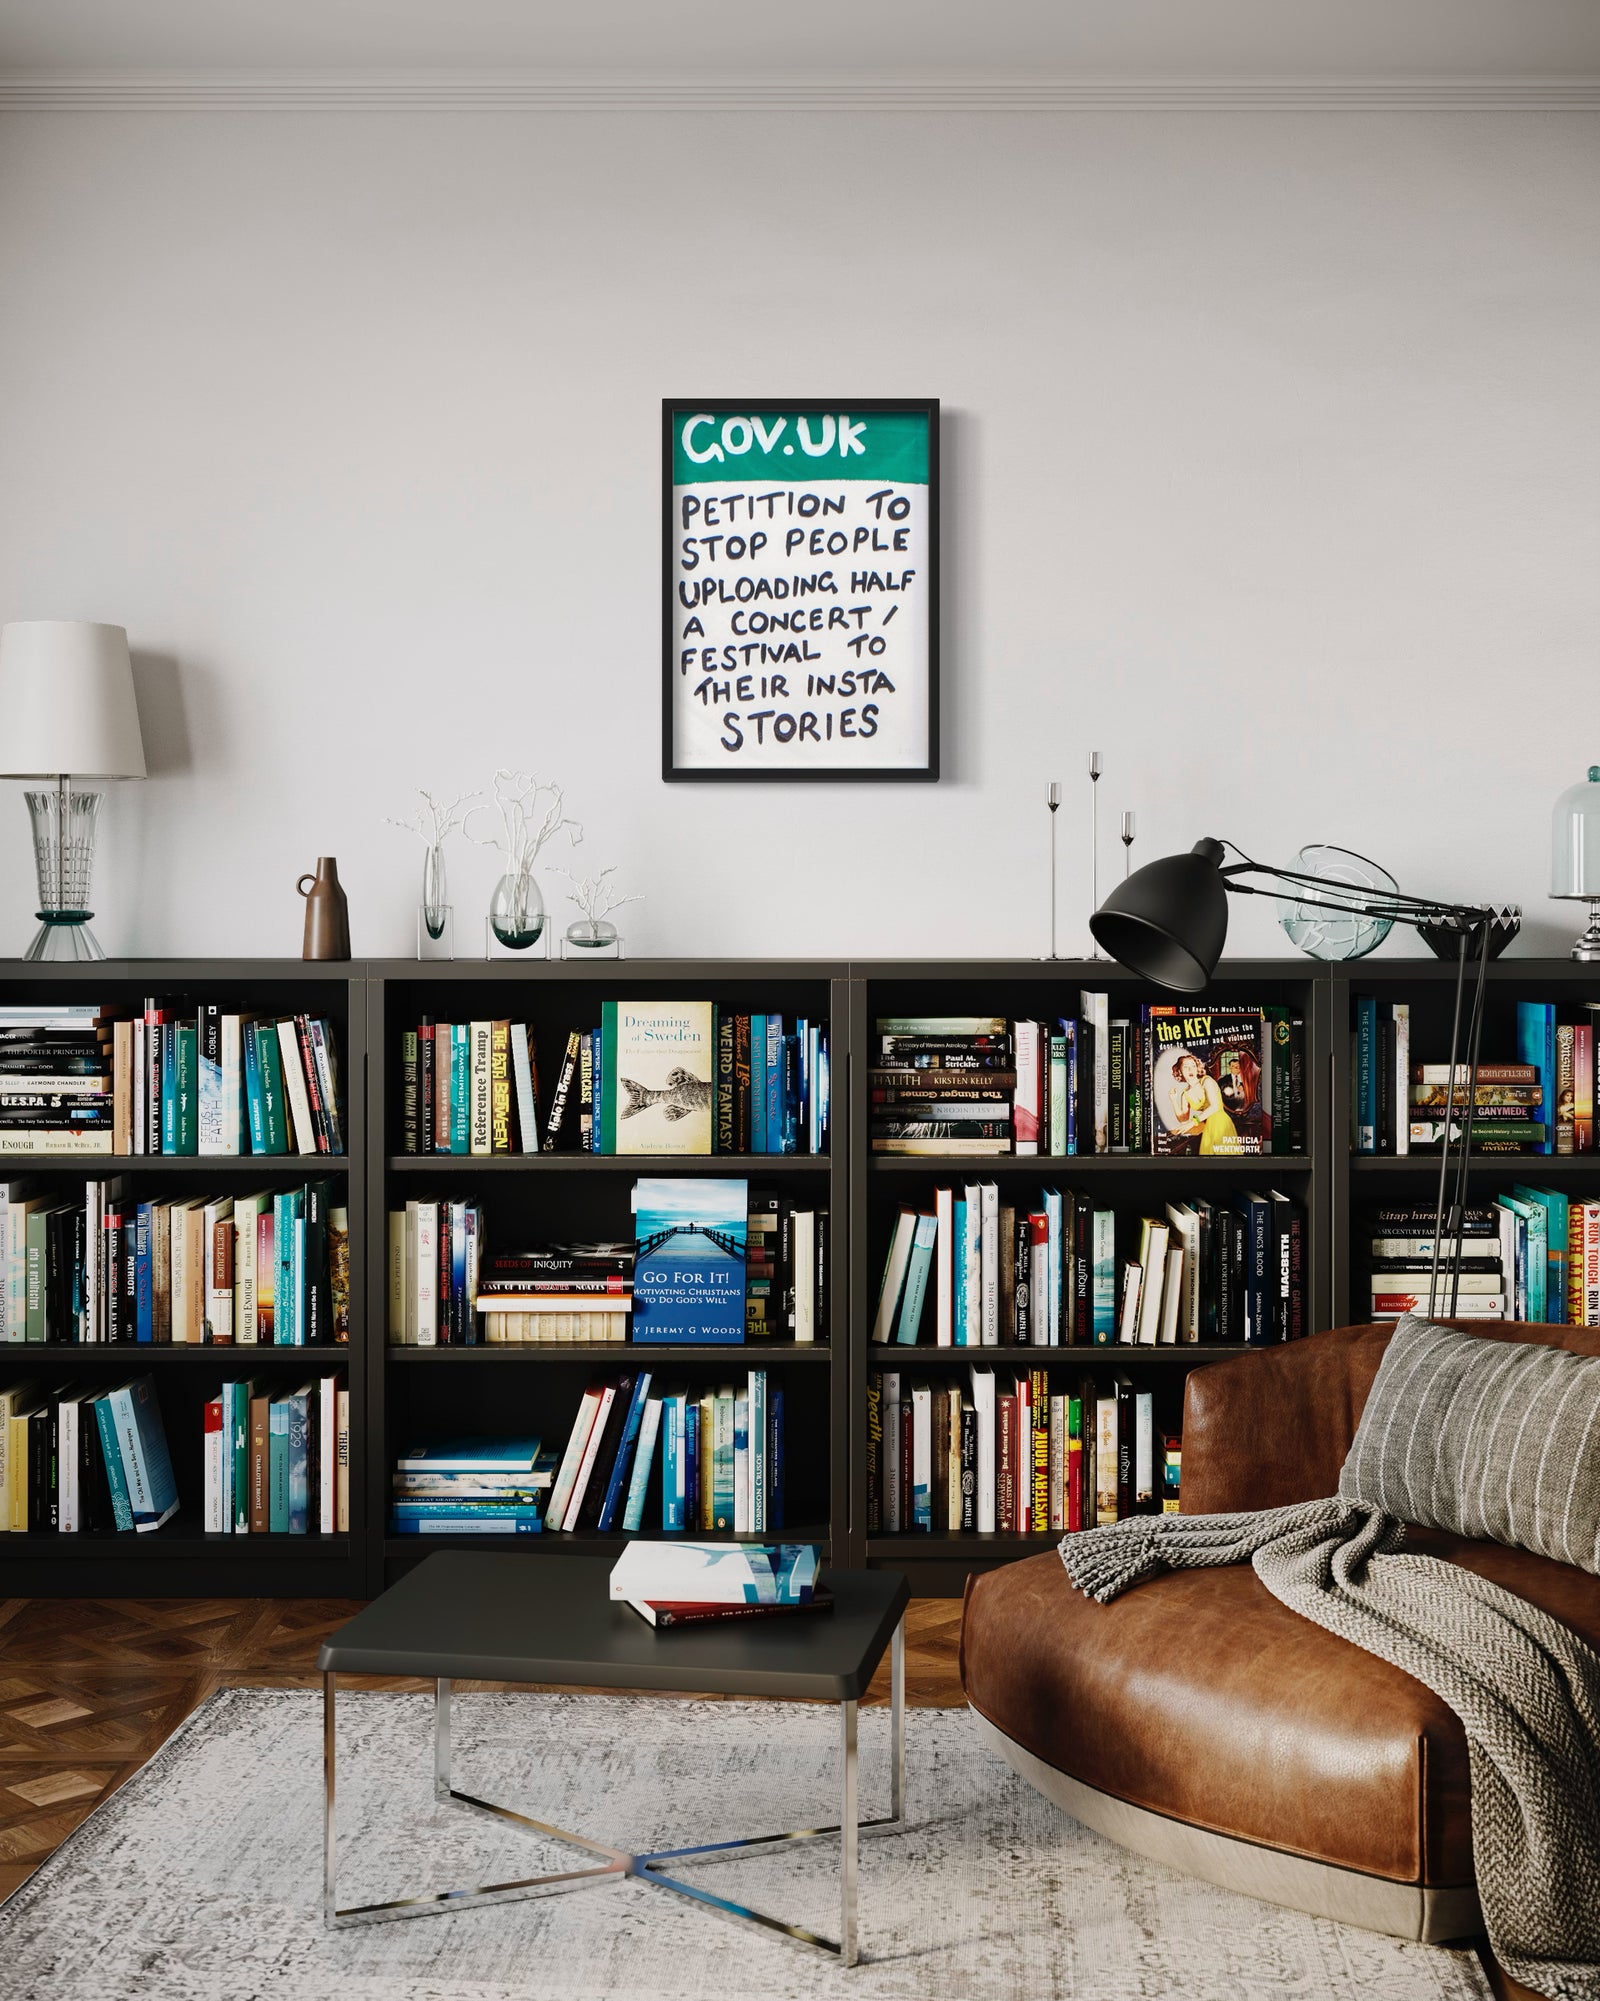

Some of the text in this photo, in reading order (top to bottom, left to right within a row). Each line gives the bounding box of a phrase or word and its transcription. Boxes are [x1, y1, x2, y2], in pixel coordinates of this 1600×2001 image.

[682, 489, 911, 530] PETITION TO
[682, 527, 911, 570] STOP PEOPLE
[680, 570, 915, 608] UPLOADING HALF
[683, 616, 705, 639] A
[682, 634, 886, 675] FESTIVAL TO
[694, 669, 895, 705] THEIR INSTA
[721, 704, 880, 752] STORIES
[625, 1016, 690, 1029] Dreaming
[644, 1029, 701, 1041] Sweden
[1157, 1022, 1182, 1042] the
[1183, 1016, 1212, 1038] KEY
[1215, 1027, 1239, 1035] unlocks
[1186, 1039, 1209, 1047] murder
[1212, 1036, 1225, 1044] and
[1228, 1033, 1255, 1042] violence
[1019, 1032, 1029, 1066] LILITH
[1112, 1034, 1121, 1090] THE HOBBIT
[474, 1031, 488, 1146] Reference Tramp
[492, 1027, 509, 1148] THE PATH BETWEEN
[581, 1050, 592, 1104] STAIRCASE
[719, 1023, 732, 1150] WEIRD FANTASY
[1479, 1069, 1532, 1078] BEETLEJUICE
[405, 1062, 416, 1152] THIS WOMAN IS MINE
[547, 1062, 574, 1131] Halo in Brass
[940, 1090, 979, 1098] Hunger
[1275, 1085, 1283, 1101] your
[1274, 1112, 1282, 1128] Title
[2, 1140, 34, 1149] ENOUGH
[1212, 1145, 1260, 1153] WENTWORTH
[1222, 1136, 1259, 1144] PATRICIA
[1256, 1210, 1264, 1224] THE
[1569, 1204, 1583, 1256] HARD
[1588, 1222, 1598, 1244] RUN
[217, 1227, 225, 1280] BEETLEJUICE
[494, 1260, 573, 1270] SEEDS OF INIQUITY
[1256, 1251, 1264, 1276] BLOOD
[1281, 1234, 1289, 1298] MACBETH
[1568, 1262, 1582, 1280] IT
[1586, 1249, 1599, 1287] TOUGH,
[127, 1256, 135, 1296] PATRIOTS
[674, 1272, 704, 1284] FOR
[688, 1288, 740, 1296] CHRISTIANS
[1292, 1219, 1300, 1339] THE SNOWS of GANYMEDE
[243, 1278, 253, 1340] ROUGH ENOUGH
[1588, 1290, 1599, 1312] RUN
[290, 1421, 302, 1447] 1929
[866, 1385, 882, 1473] Death WISH
[339, 1430, 348, 1467] THRIFT
[1055, 1418, 1063, 1506] PIRATES OF THE CARIBBEAN
[1120, 1444, 1130, 1484] INIQUITY
[997, 1473, 1005, 1520] HOGWARTS
[1035, 1430, 1048, 1532] MYSTERY BOOK
